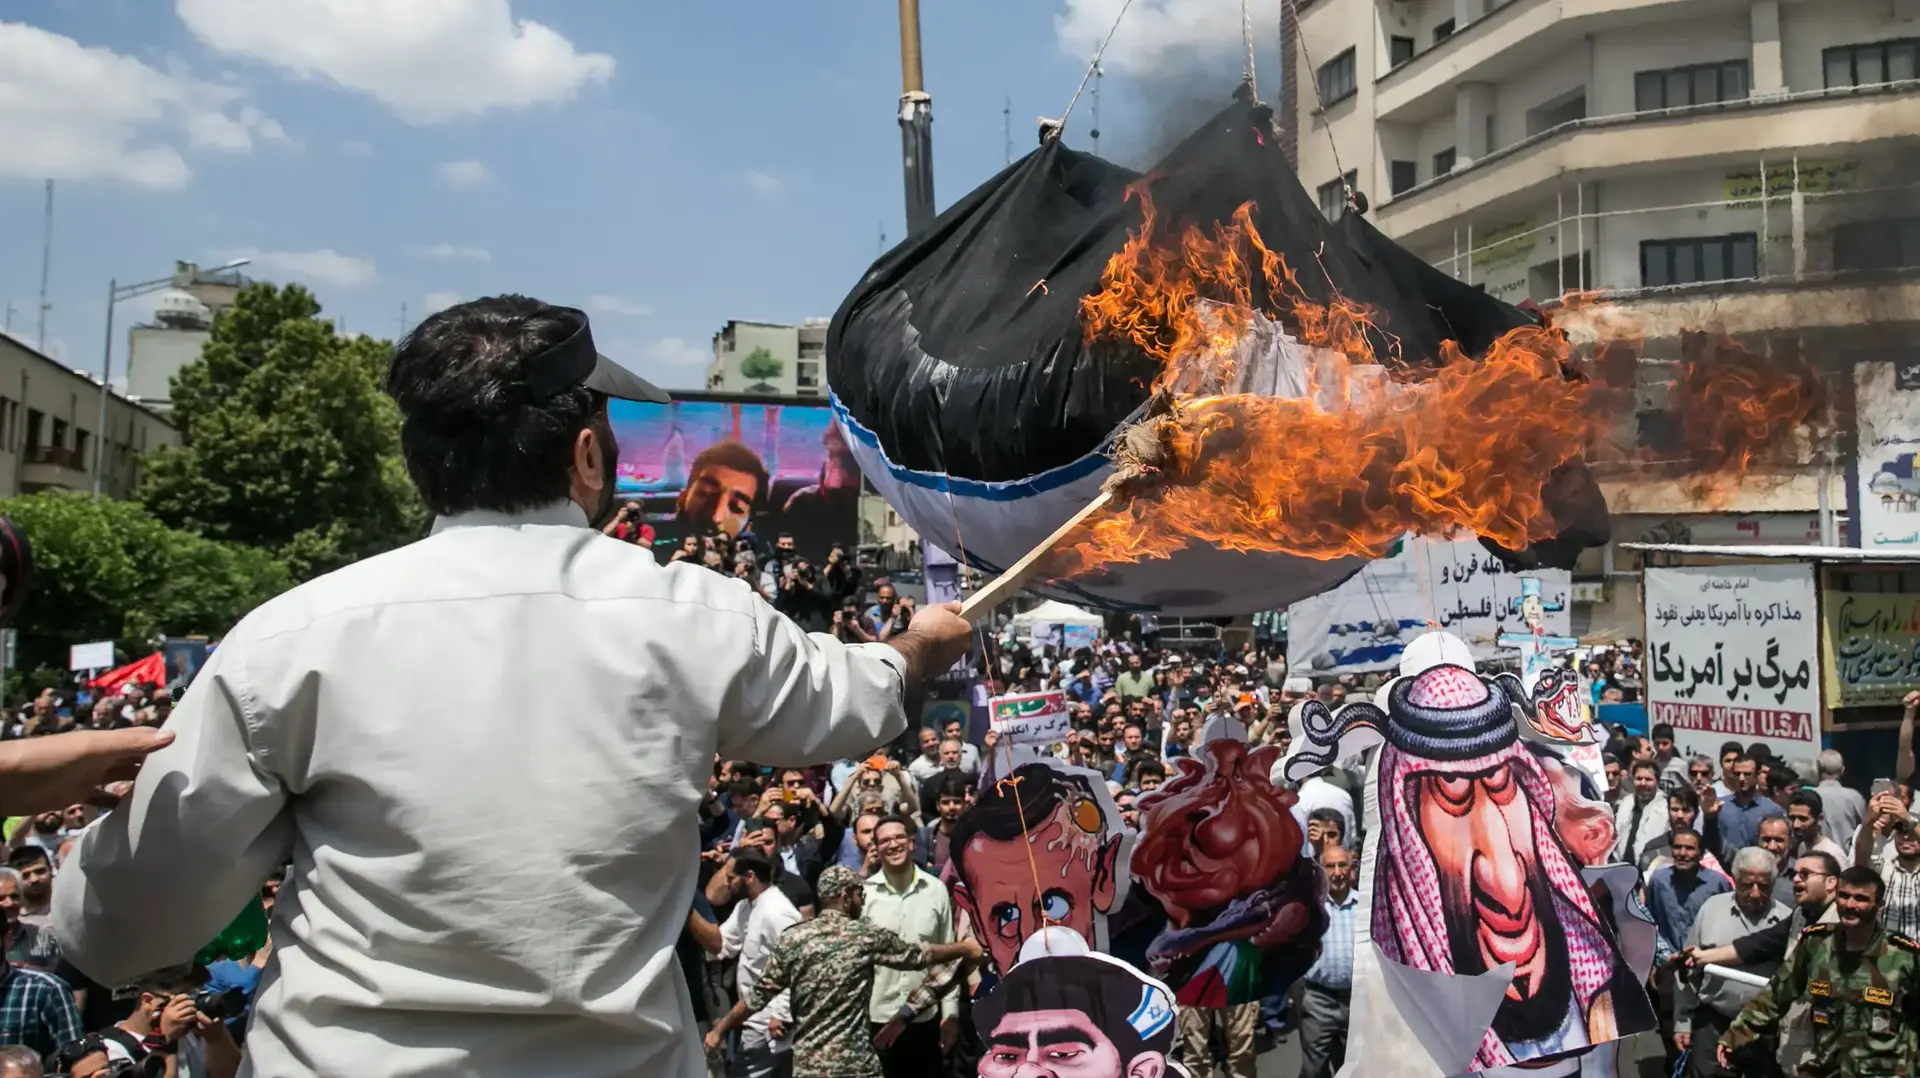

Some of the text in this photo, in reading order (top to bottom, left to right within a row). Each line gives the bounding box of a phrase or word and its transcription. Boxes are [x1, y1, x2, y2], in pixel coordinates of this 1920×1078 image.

[1873, 531, 1919, 545] است
[1440, 565, 1449, 584] و
[1452, 552, 1479, 583] قرن
[1440, 596, 1492, 628] فلسطین
[1655, 599, 1802, 628] مذاکره با آمریکا یعنی نفوذ
[1650, 637, 1810, 705] مرگ بر آمریکا
[1652, 703, 1812, 740] DOWN WITH U.S.A
